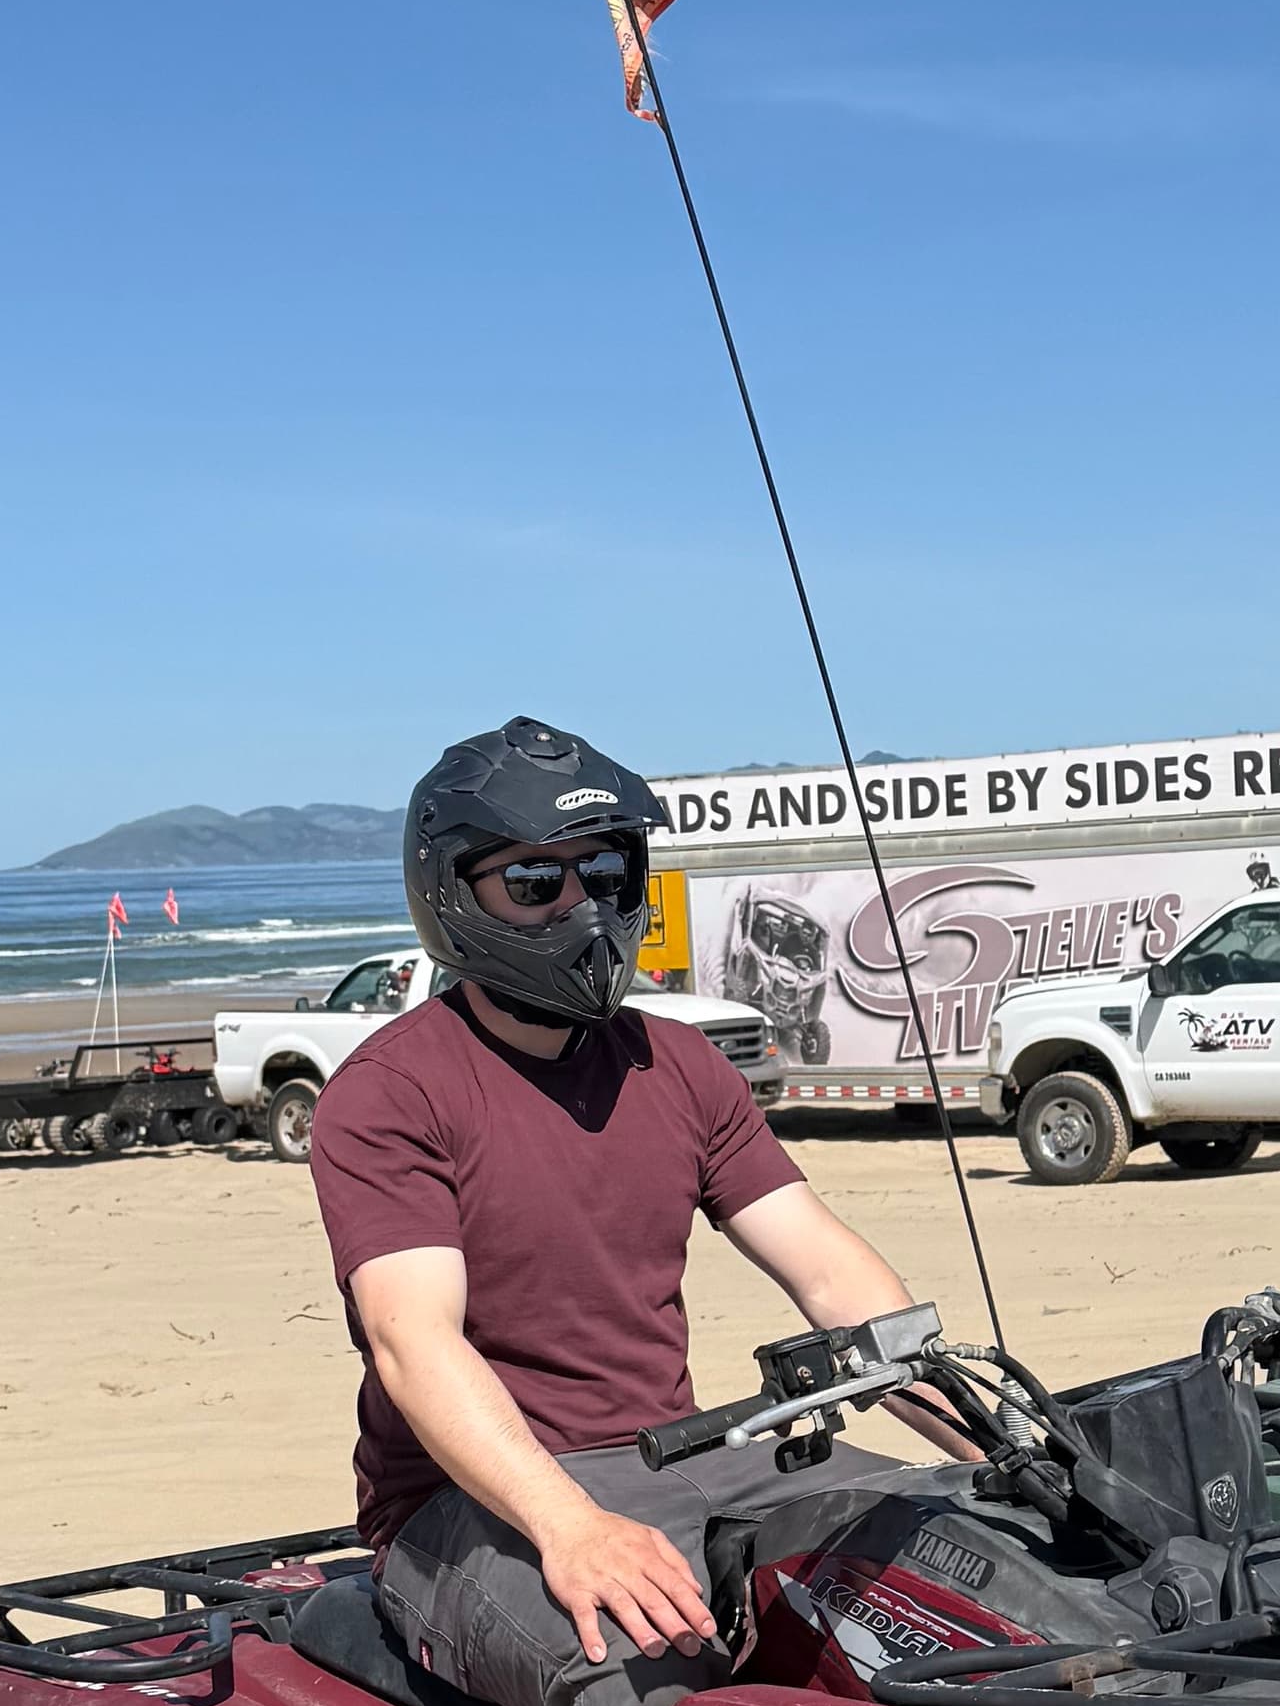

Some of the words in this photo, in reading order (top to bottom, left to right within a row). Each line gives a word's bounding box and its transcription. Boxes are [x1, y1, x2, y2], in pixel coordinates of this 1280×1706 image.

[747, 783, 847, 829] AND
[865, 773, 968, 823] SIDE
[987, 766, 1048, 813] BY
[1065, 754, 1212, 809] SIDES
[899, 982, 1000, 1061] ATV
[1222, 1018, 1276, 1036] ATV
[908, 1530, 989, 1588] YAMAHA
[867, 1591, 893, 1609] FUEL
[894, 1604, 952, 1637] INJECTION
